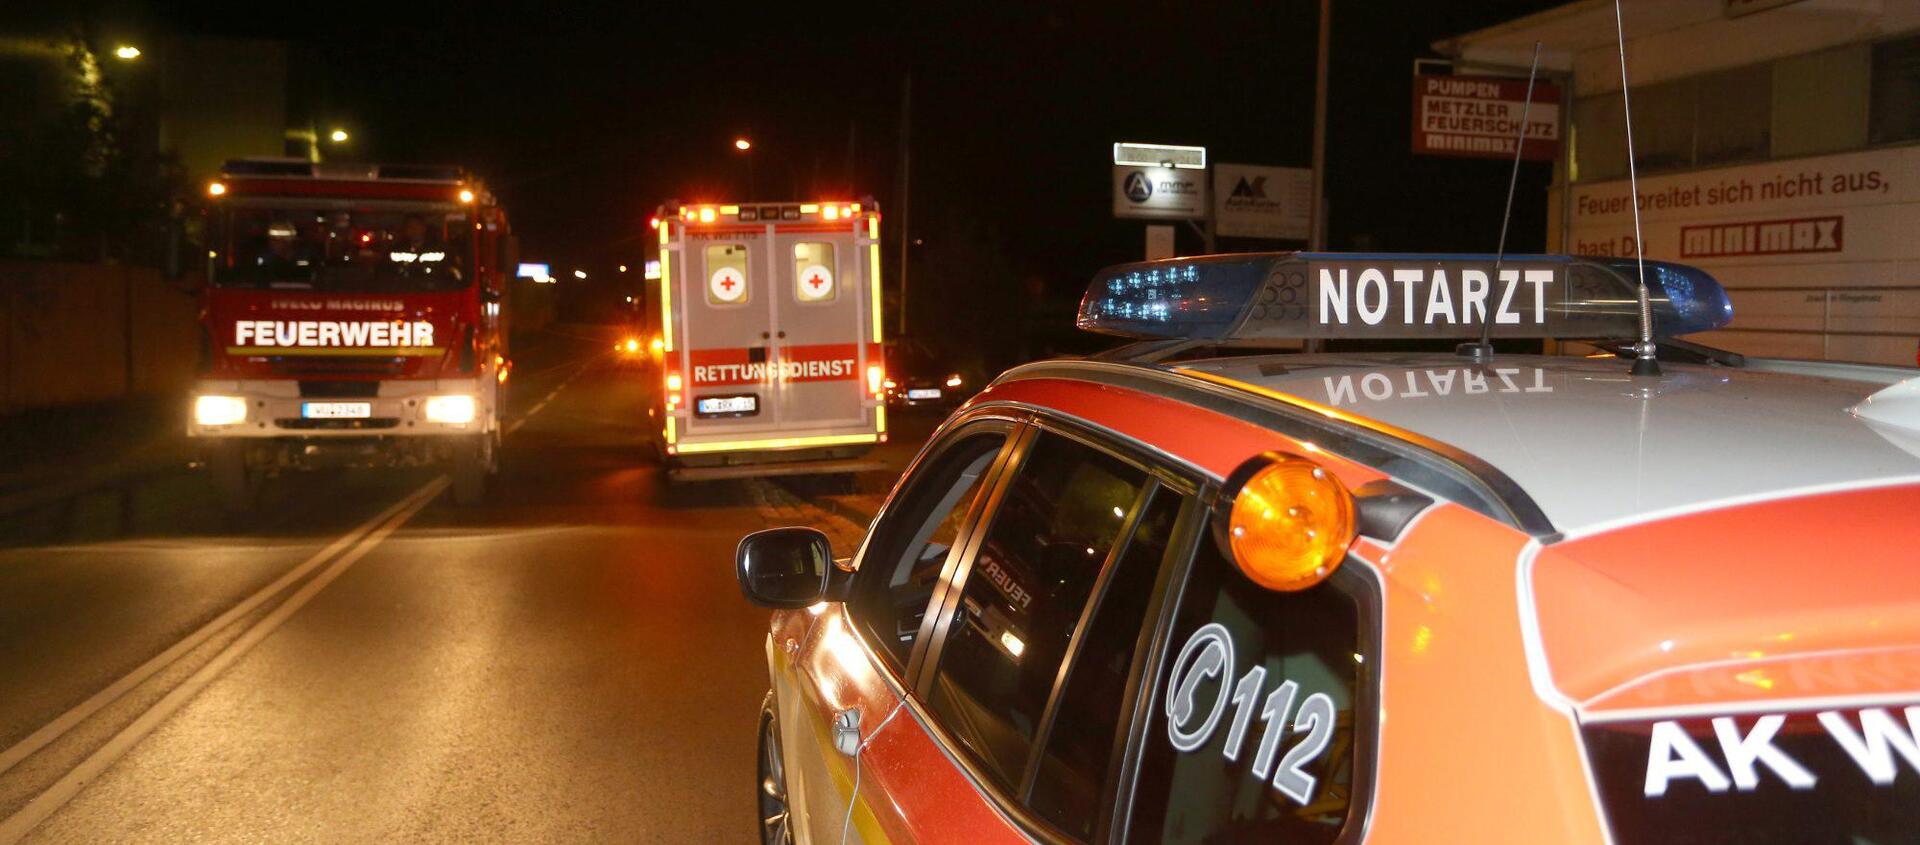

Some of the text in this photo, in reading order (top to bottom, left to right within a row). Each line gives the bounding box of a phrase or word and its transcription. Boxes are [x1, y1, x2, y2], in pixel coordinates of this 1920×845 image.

[1427, 79, 1500, 98] PUMPEN
[1427, 100, 1509, 118] METZLER
[1427, 116, 1553, 137] FEUERSCHUTZ
[1577, 169, 1890, 216] Feuer breitet sich nicht aus,
[1577, 239, 1616, 257] hast
[1621, 236, 1648, 257] Du
[1318, 268, 1554, 325] NOTARZT
[235, 320, 434, 347] FEUERWEHR
[694, 359, 855, 383] RETTUNGSDIENST
[1223, 665, 1335, 806] 112
[1644, 714, 1818, 798] AK
